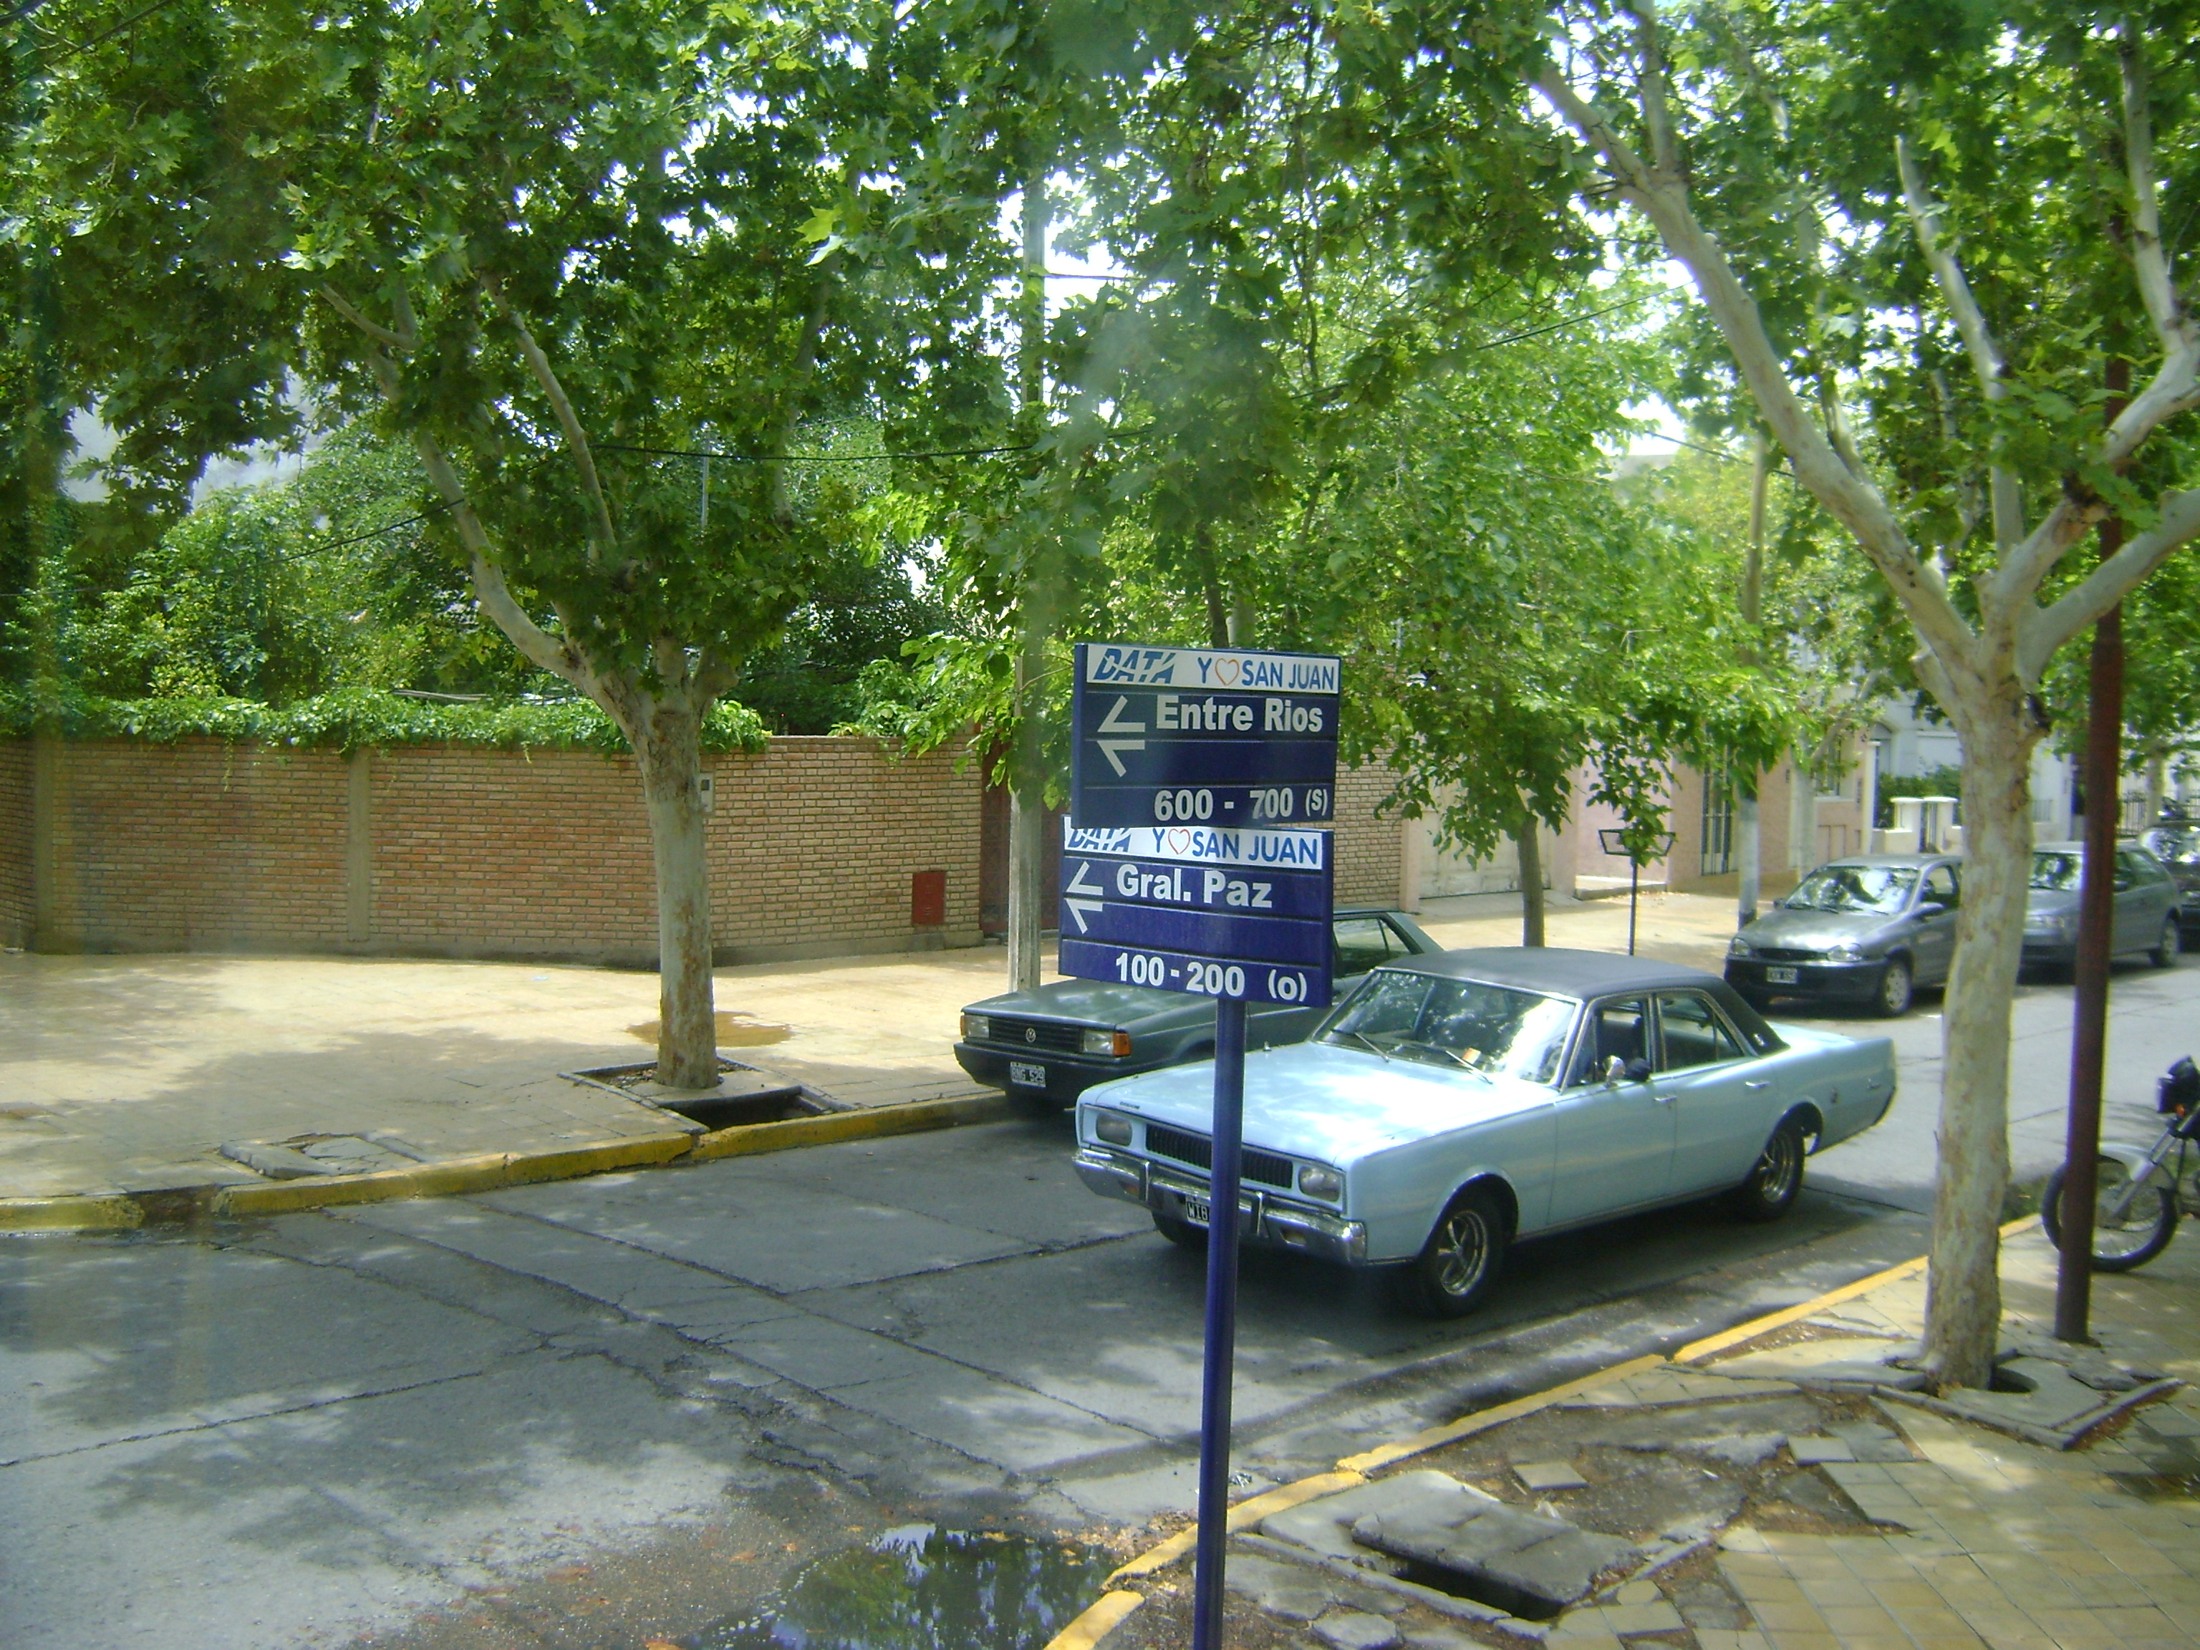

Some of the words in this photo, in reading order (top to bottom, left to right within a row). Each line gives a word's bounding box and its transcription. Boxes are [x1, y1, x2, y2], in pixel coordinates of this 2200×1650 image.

[1093, 648, 1176, 685] DATA
[1197, 657, 1212, 684] Y
[1242, 657, 1283, 688] SAN
[1288, 664, 1334, 691] JUAN
[1156, 695, 1253, 731] Entre
[1264, 698, 1323, 732] Rios
[1154, 788, 1214, 821] 600
[1249, 787, 1293, 819] 700
[1152, 828, 1166, 853] Y
[1192, 831, 1239, 858] SAN
[1248, 836, 1318, 865] JUAN
[1116, 863, 1191, 902] Gral.
[1203, 870, 1272, 909] Paz
[1115, 952, 1164, 987] 100
[1186, 961, 1245, 997] 200
